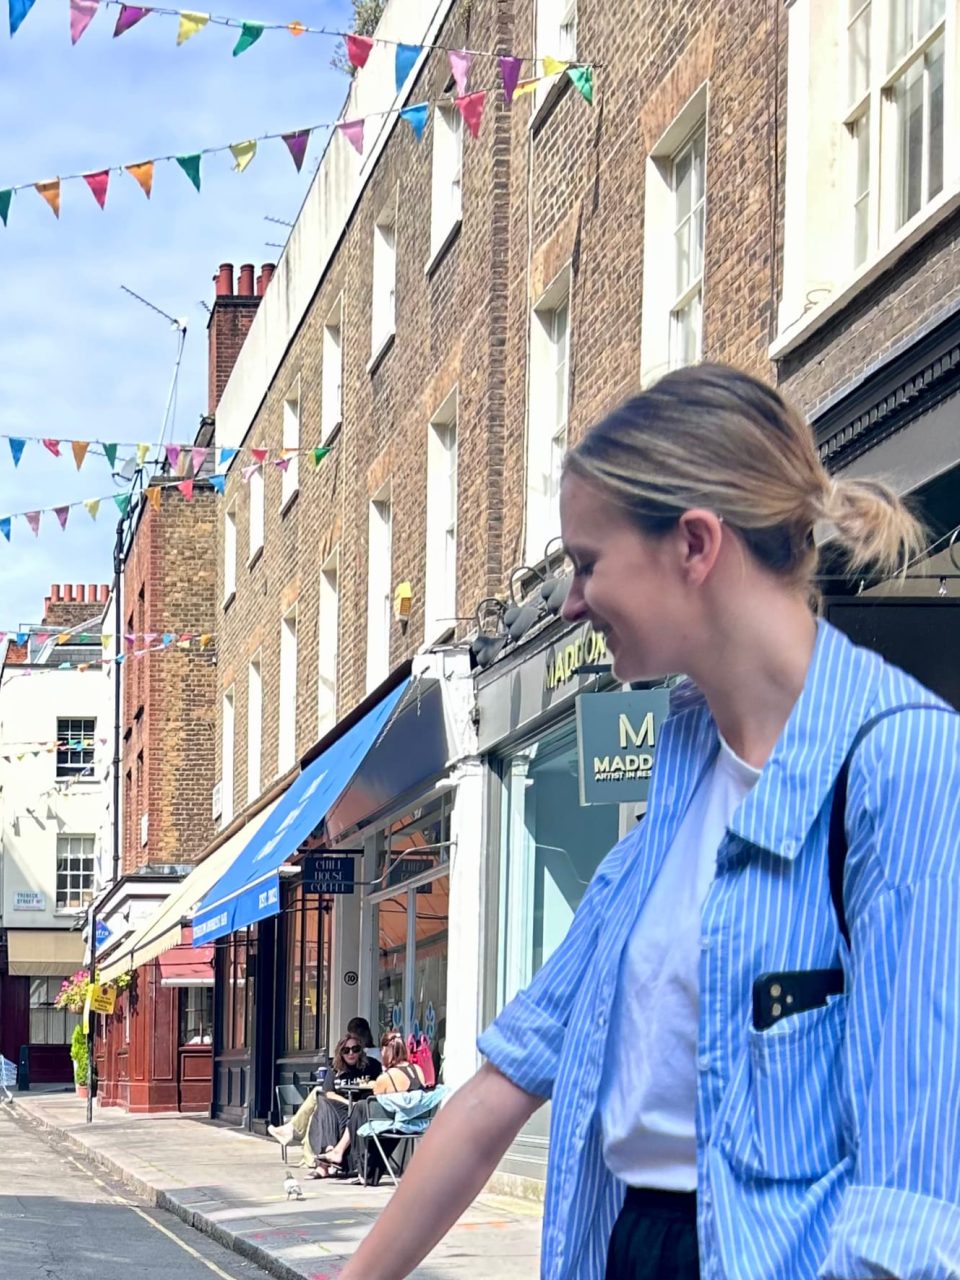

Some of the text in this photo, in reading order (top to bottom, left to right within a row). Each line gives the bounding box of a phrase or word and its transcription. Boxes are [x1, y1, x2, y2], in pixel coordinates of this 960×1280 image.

[619, 712, 655, 748] M
[594, 754, 653, 773] MADD
[595, 772, 624, 780] ARTIST
[315, 861, 343, 870] CHILL
[314, 871, 342, 880] HOUSE
[310, 882, 345, 892] COFFEE
